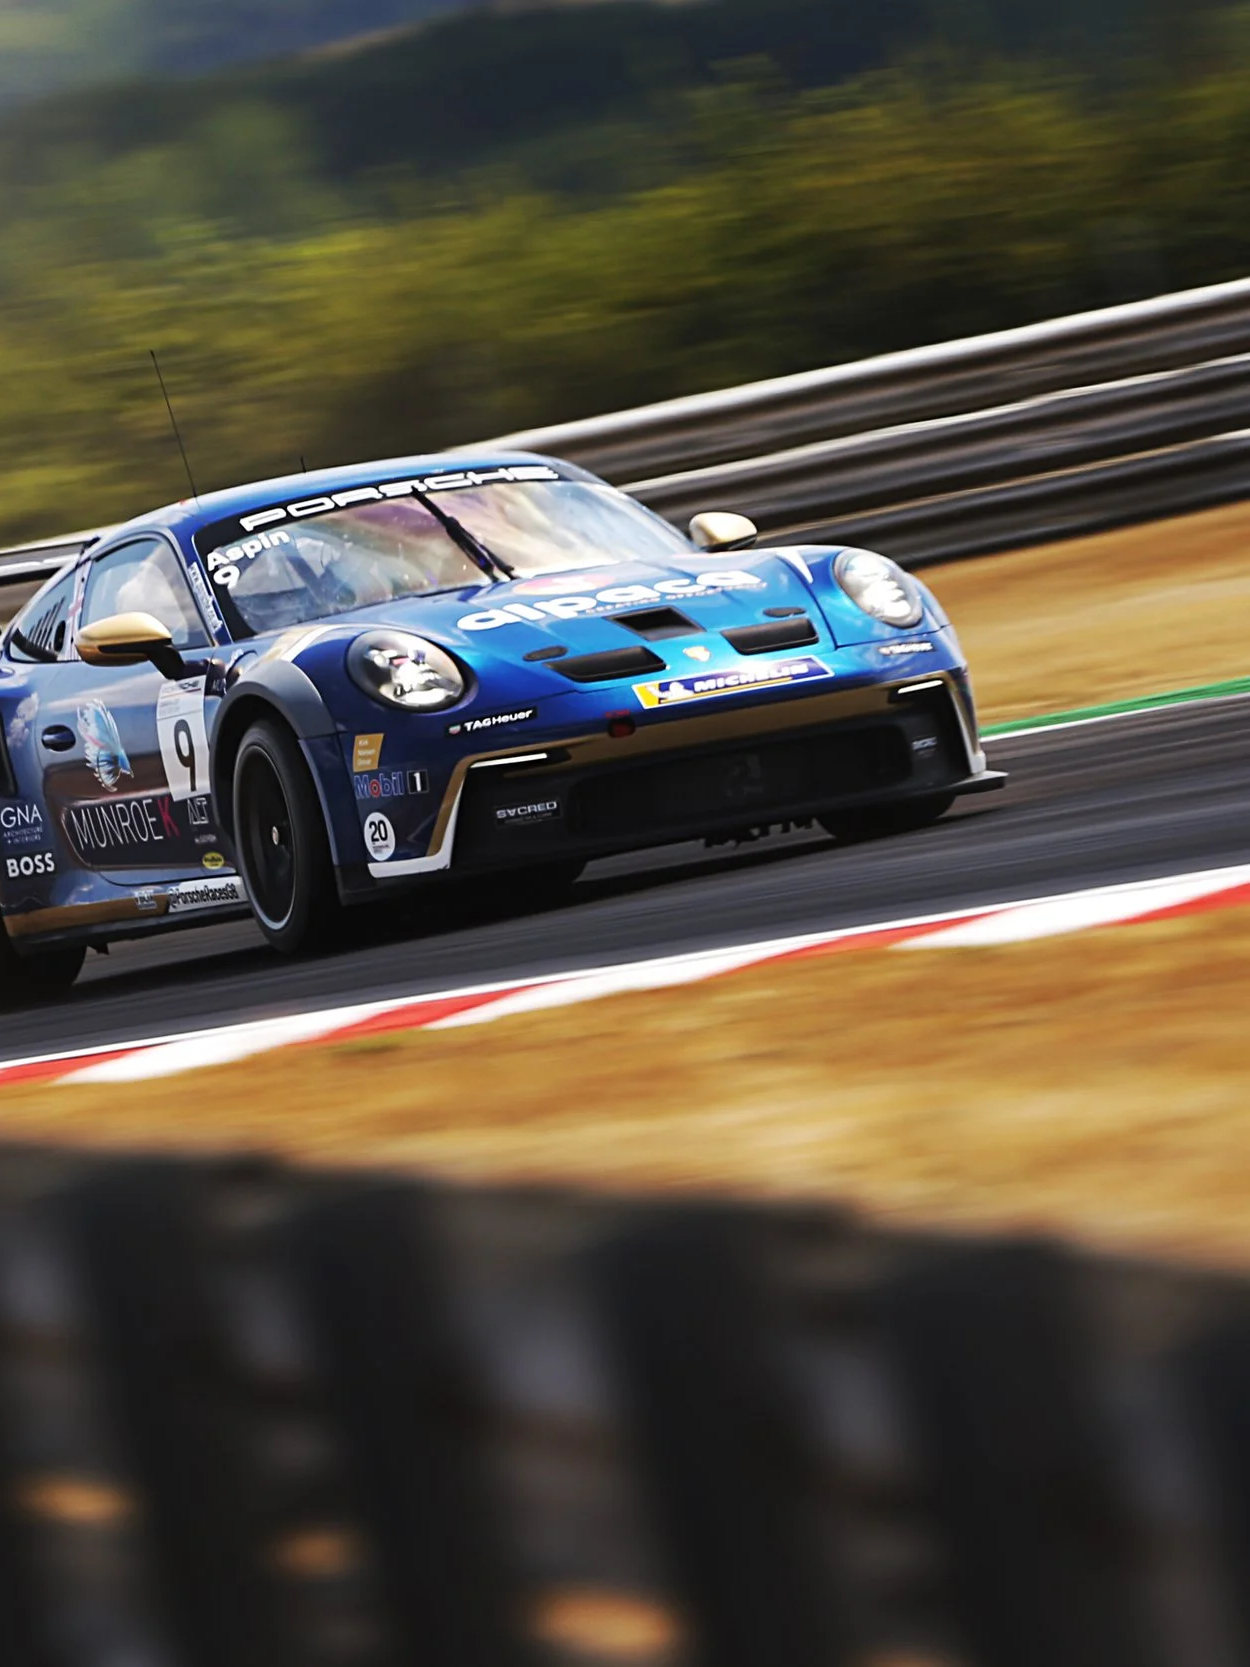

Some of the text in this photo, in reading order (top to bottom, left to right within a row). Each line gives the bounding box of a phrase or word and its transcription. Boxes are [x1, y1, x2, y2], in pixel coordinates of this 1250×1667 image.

[239, 466, 559, 531] PORSCHE
[206, 529, 290, 571] Aspin
[214, 566, 240, 589] 9
[456, 567, 762, 631] alpaca
[693, 663, 810, 693] MICHELIN
[173, 719, 196, 792] 9
[354, 771, 422, 799] Mobil 1
[0, 803, 43, 828] GNA
[496, 801, 558, 818] SACRED
[368, 819, 388, 842] 20
[6, 852, 55, 878] BOSS
